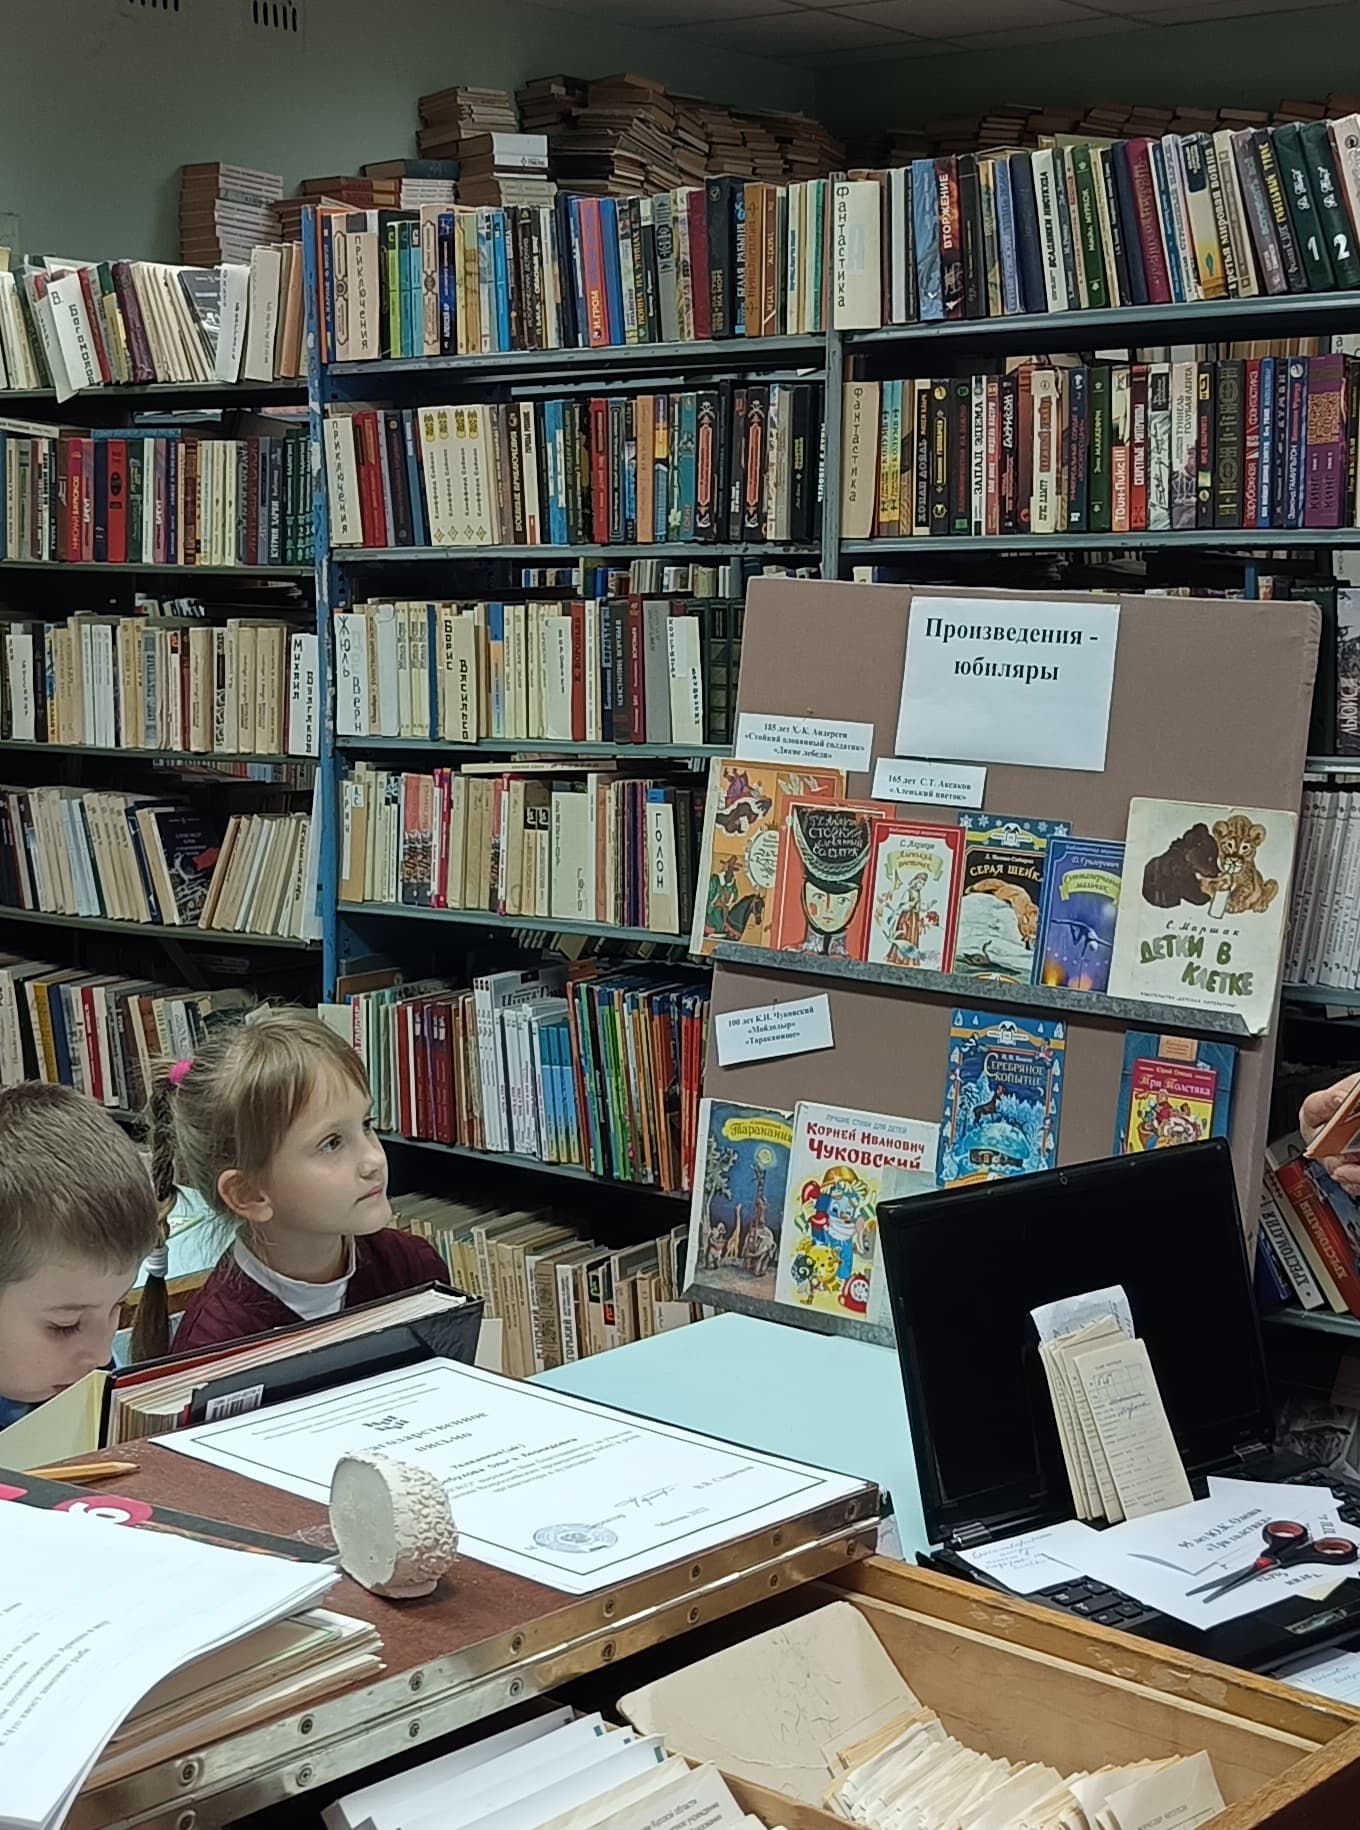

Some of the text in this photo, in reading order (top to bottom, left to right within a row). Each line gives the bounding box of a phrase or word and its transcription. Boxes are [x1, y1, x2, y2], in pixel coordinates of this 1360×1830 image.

[940, 174, 952, 249] ВТОРЖЕНИЕ
[836, 185, 849, 308] Фантастика
[1306, 236, 1320, 261] 1
[1333, 234, 1351, 260] 2
[354, 236, 368, 349] ПРИКЛЮЧЕНИЯ
[925, 617, 1083, 646] Произведения
[953, 657, 1059, 682] юбиляры
[969, 864, 1005, 878] СЕРАЯ
[1179, 922, 1240, 937] Маршак
[1140, 934, 1232, 965] ДЕТКИ В
[1181, 961, 1254, 996] КЛЕТКЕ
[773, 1006, 814, 1021] Чуковский
[1299, 1201, 1348, 1280] ХРЕСТОМАТИЯ
